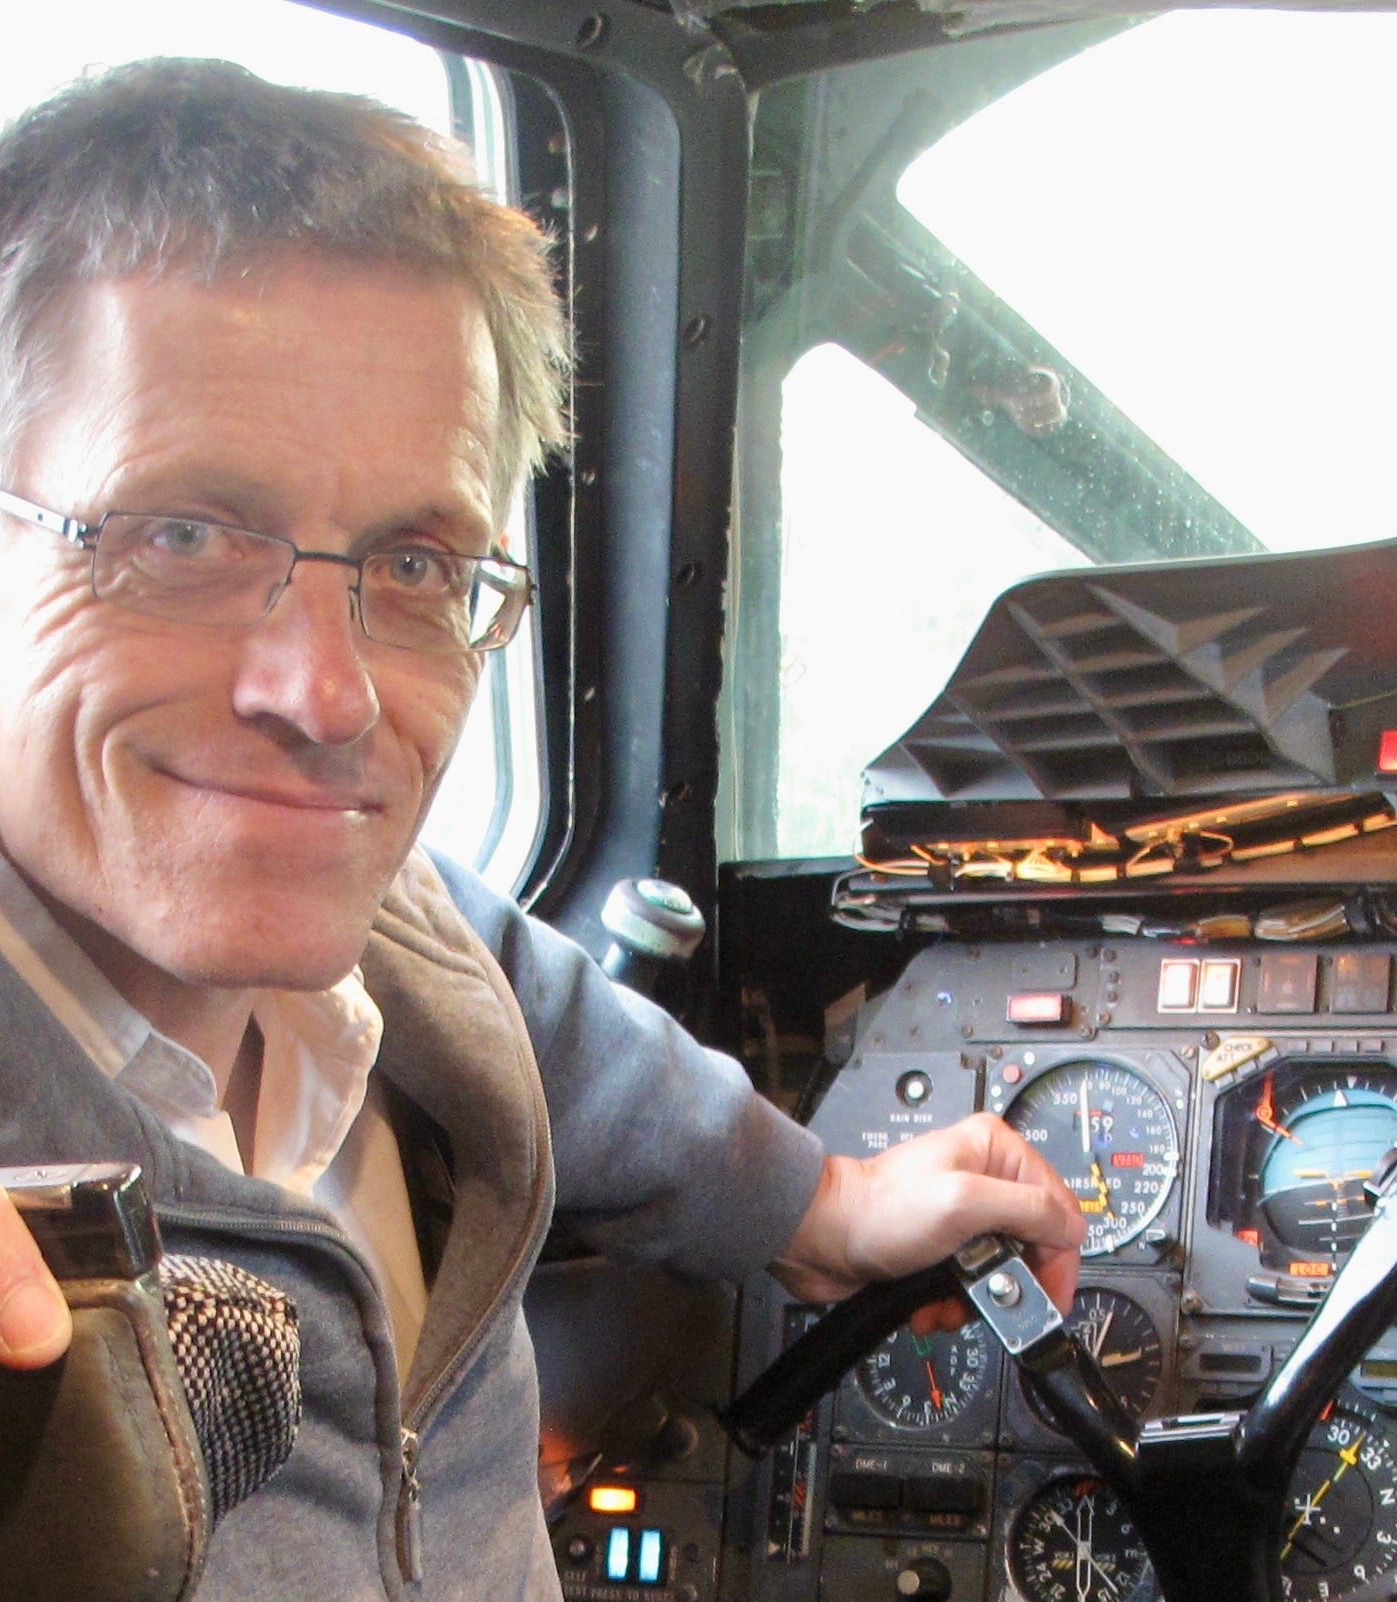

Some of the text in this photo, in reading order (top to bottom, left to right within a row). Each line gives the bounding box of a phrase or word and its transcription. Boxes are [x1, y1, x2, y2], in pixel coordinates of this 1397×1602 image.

[1223, 1043, 1255, 1053] CHECK
[1053, 1092, 1079, 1106] 550
[1024, 1129, 1049, 1143] 500
[1142, 1163, 1164, 1176] 200
[1064, 1177, 1122, 1190] AIRSED
[1134, 1181, 1159, 1194] 220
[1120, 1201, 1145, 1216] 250
[1102, 1216, 1128, 1230] 300
[1326, 1425, 1352, 1446] 30
[855, 1458, 889, 1471] DME-1
[1360, 1447, 1383, 1472] 33
[1378, 1487, 1397, 1506] N
